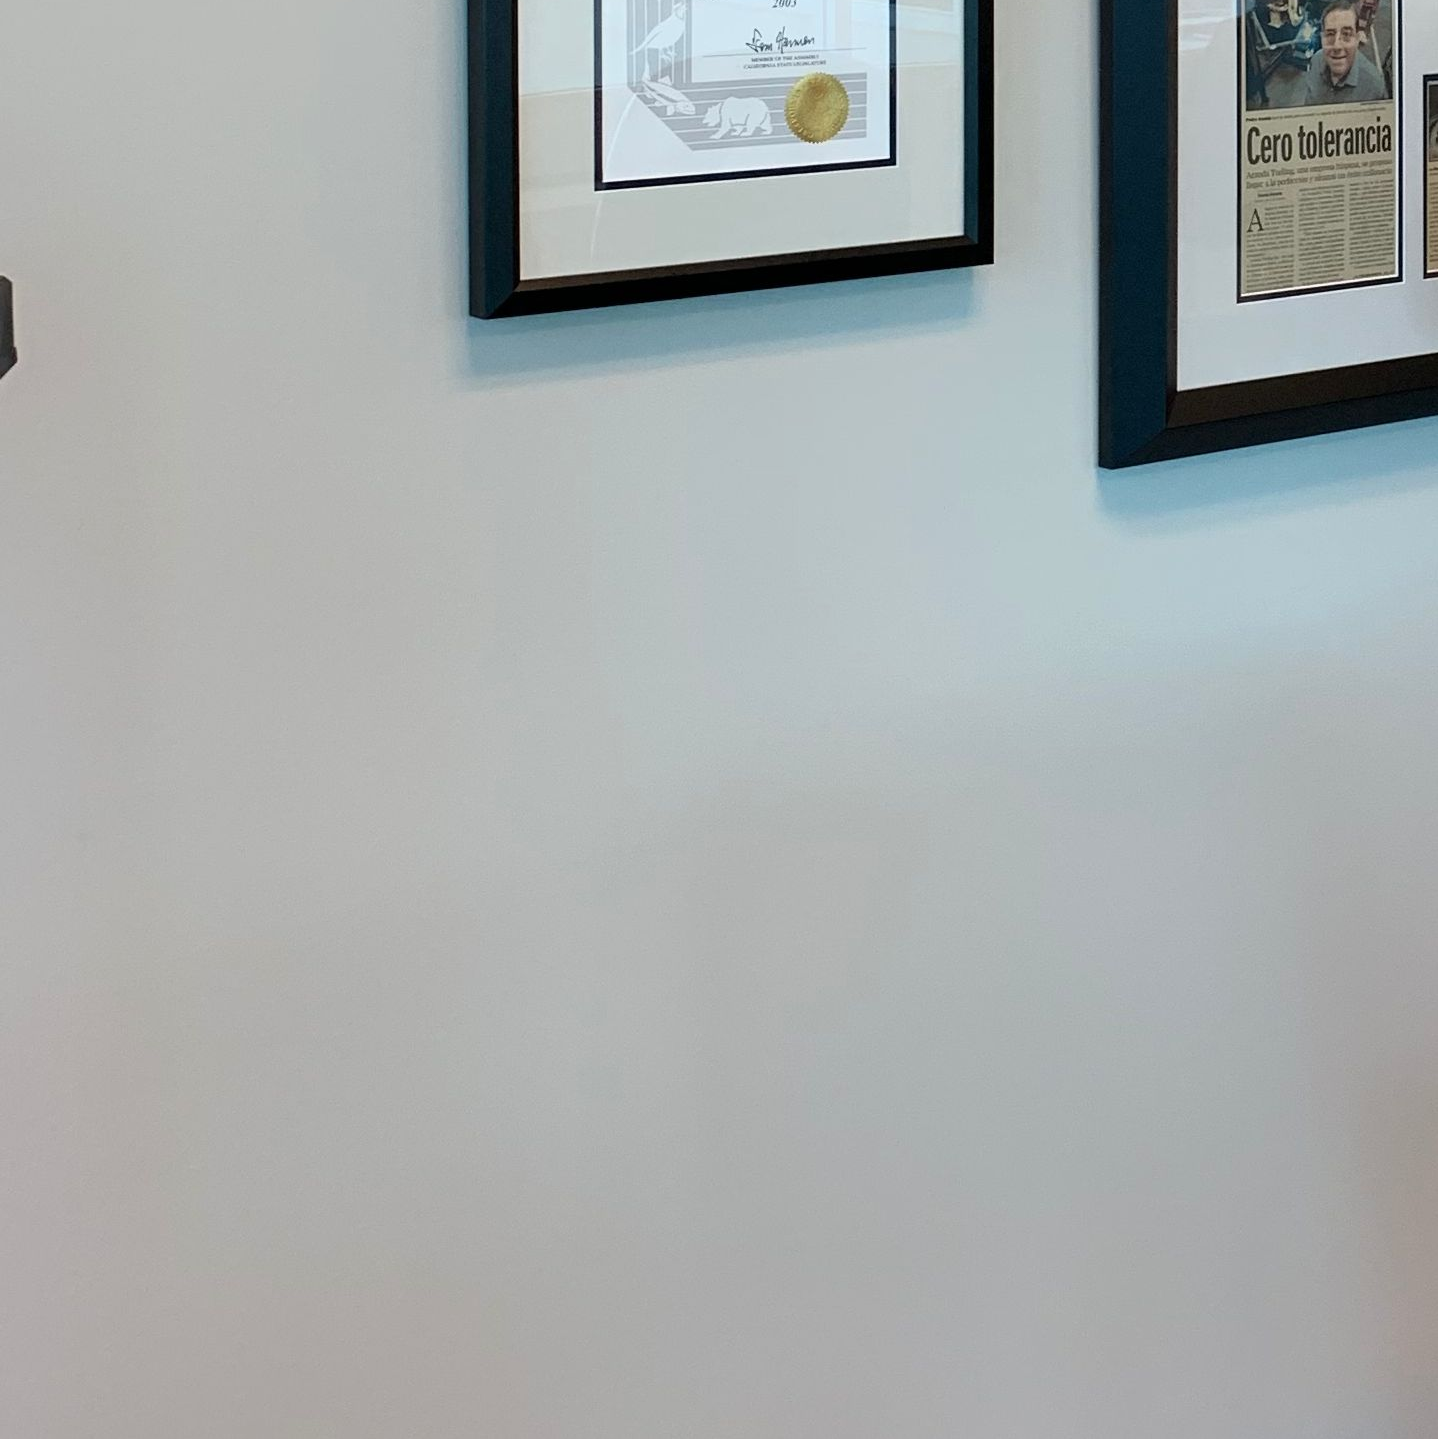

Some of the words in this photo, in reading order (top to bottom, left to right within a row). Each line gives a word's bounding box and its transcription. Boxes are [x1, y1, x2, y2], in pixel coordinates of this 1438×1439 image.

[1246, 125, 1293, 166] Cero
[1297, 117, 1393, 159] tolerancia
[1247, 207, 1264, 233] A
